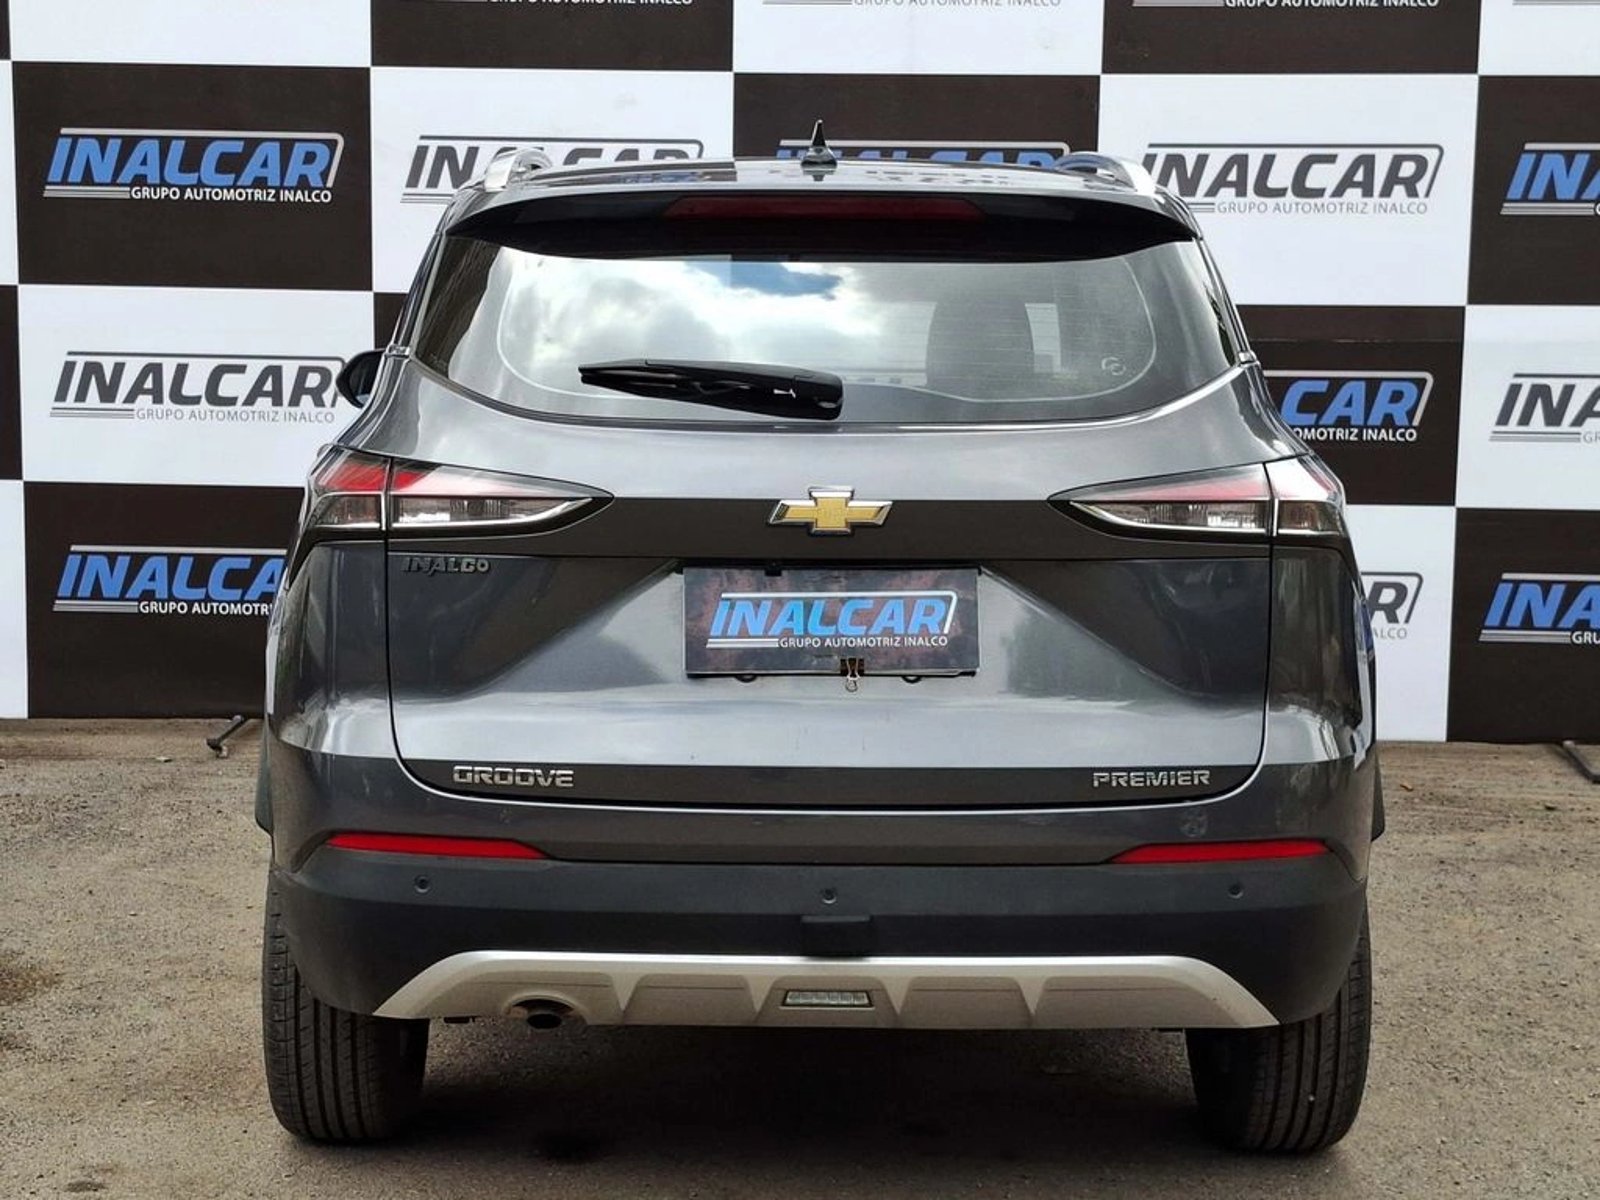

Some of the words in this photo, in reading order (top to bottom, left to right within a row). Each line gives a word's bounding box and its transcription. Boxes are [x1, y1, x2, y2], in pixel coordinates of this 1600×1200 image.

[46, 136, 332, 188] INALCAR
[1506, 153, 1600, 200] IN
[131, 186, 180, 200] GRUPO
[184, 187, 276, 202] AUTOMOTRIZ
[280, 189, 332, 203] INALCO
[1217, 201, 1268, 214] GRUPO
[1272, 201, 1368, 215] AUTOMOTRIZ
[1373, 202, 1428, 215] INALCO
[53, 360, 333, 408] INALCAR
[136, 407, 185, 421] GRUPO
[189, 409, 279, 423] AUTOMOTRIZ
[284, 411, 335, 424] INALCO
[1362, 428, 1417, 441] INALCO
[139, 601, 188, 615] GRUPO
[192, 602, 272, 616] AUTOMOTR
[1484, 582, 1600, 629] INA
[709, 599, 948, 636] INALCAR
[780, 637, 821, 648] GRUPO
[824, 637, 901, 648] AUTOMOTRIZ
[904, 635, 948, 647] INALCO
[453, 765, 575, 788] GROOVE
[1092, 769, 1211, 788] PREMIER
